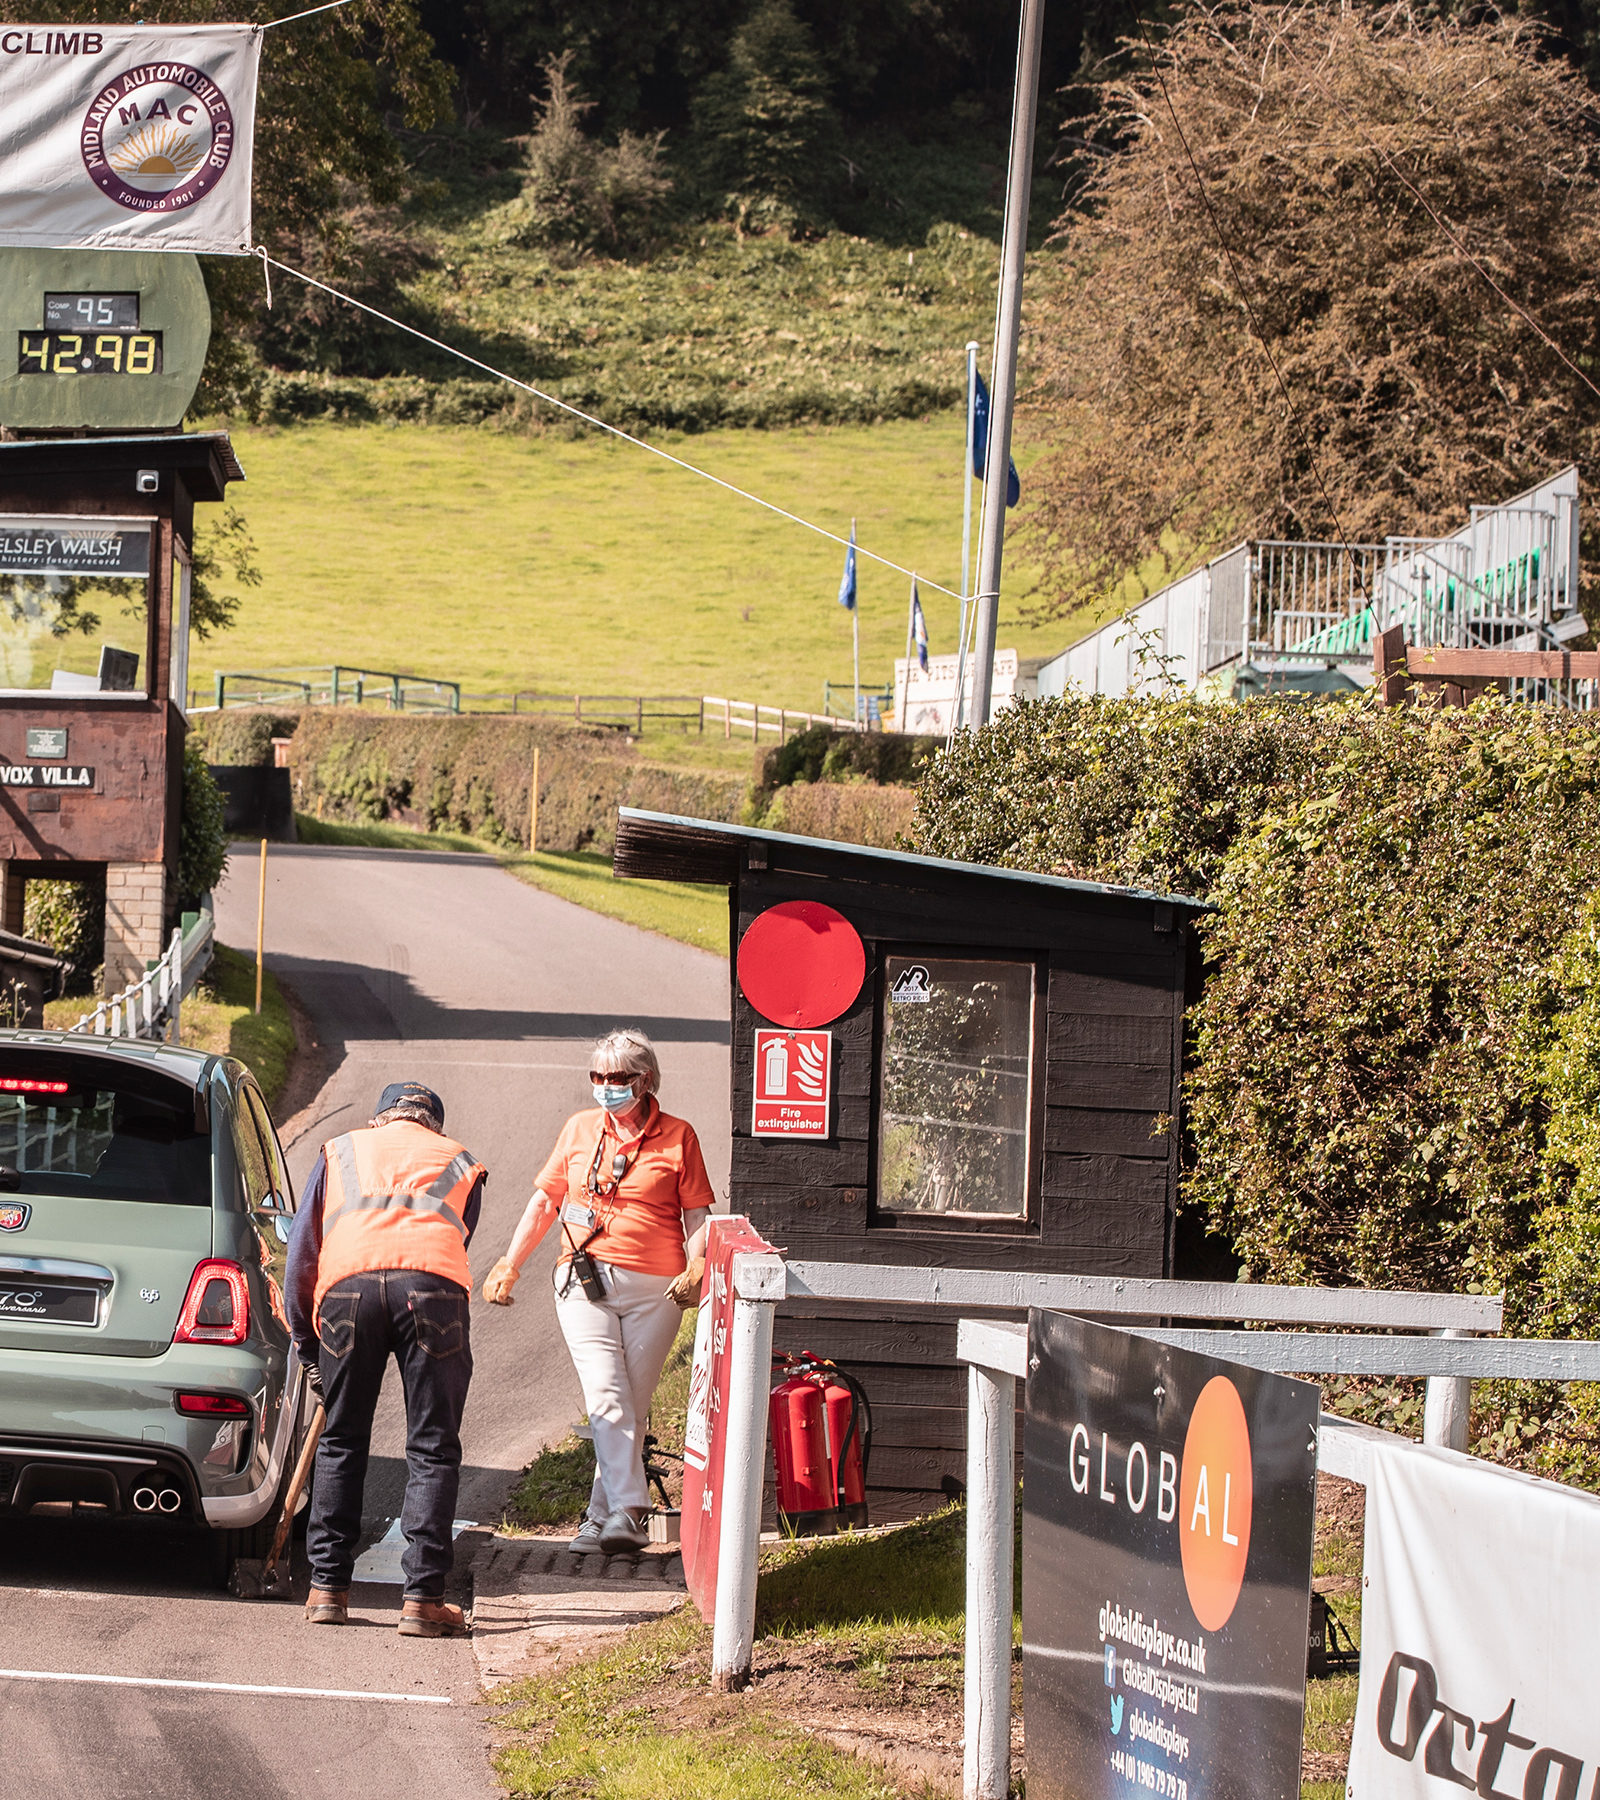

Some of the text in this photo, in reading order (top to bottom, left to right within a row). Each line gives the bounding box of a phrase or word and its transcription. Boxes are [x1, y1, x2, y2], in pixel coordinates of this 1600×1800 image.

[1, 32, 104, 55] CLIMB
[83, 65, 231, 169] MIDLAND AUTOMOBILE CLUB
[118, 97, 198, 126] MAC
[118, 190, 194, 209] FOUNDED 1901
[77, 298, 113, 324] 95
[22, 335, 156, 374] 42.98
[1, 555, 38, 564] history
[46, 556, 78, 565] future
[81, 556, 120, 565] records
[61, 539, 122, 556] WALSH
[0, 765, 90, 786] VOX VILLA
[757, 1118, 823, 1131] extinguisher
[780, 1107, 801, 1118] Fire
[1069, 1423, 1238, 1546] GLOBAL
[1099, 1600, 1207, 1674] globaldisplays.co.uk
[1122, 1658, 1198, 1714] GlobalDisplaysLtd
[1129, 1707, 1189, 1763] globaldisplays
[1377, 1651, 1600, 1800] Octa
[1110, 1750, 1188, 1800] +44 (0) 1905 79 79 78
